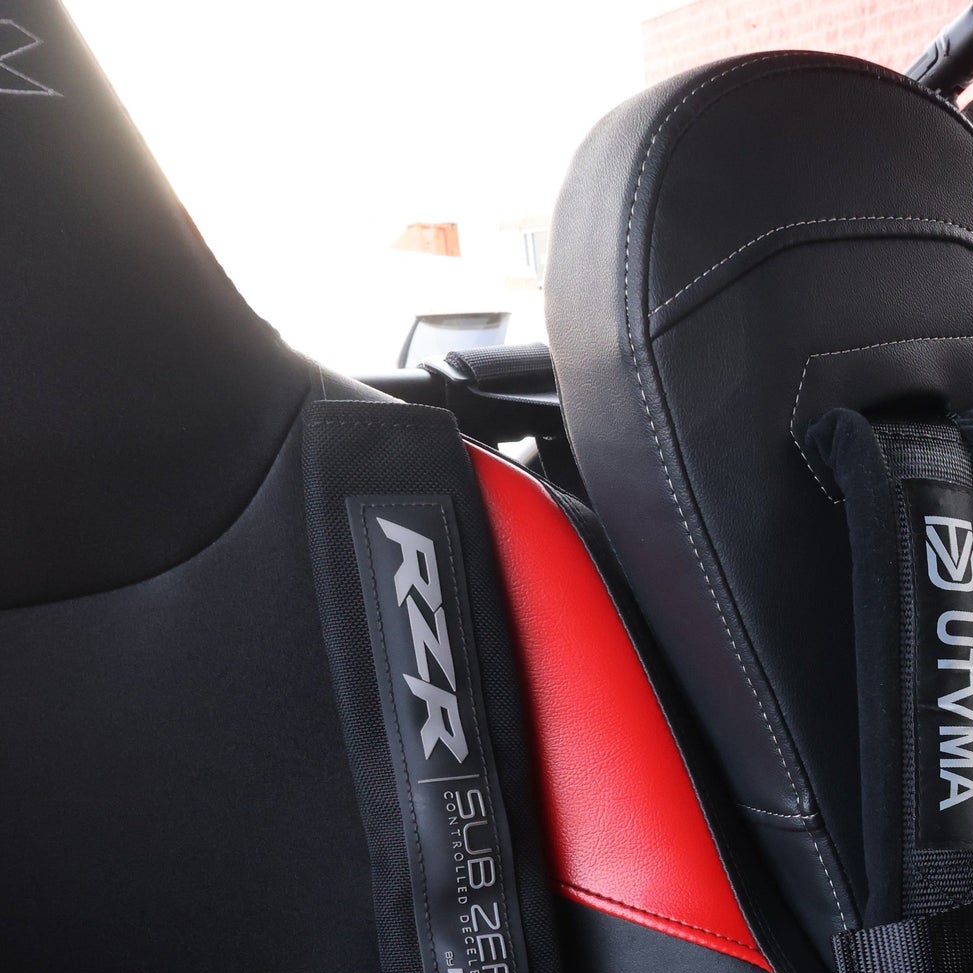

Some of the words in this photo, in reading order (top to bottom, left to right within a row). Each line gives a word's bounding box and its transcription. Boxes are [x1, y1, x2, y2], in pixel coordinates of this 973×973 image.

[376, 516, 470, 764] RZR
[444, 791, 468, 905] CONTROLLED
[455, 789, 495, 889] SUB
